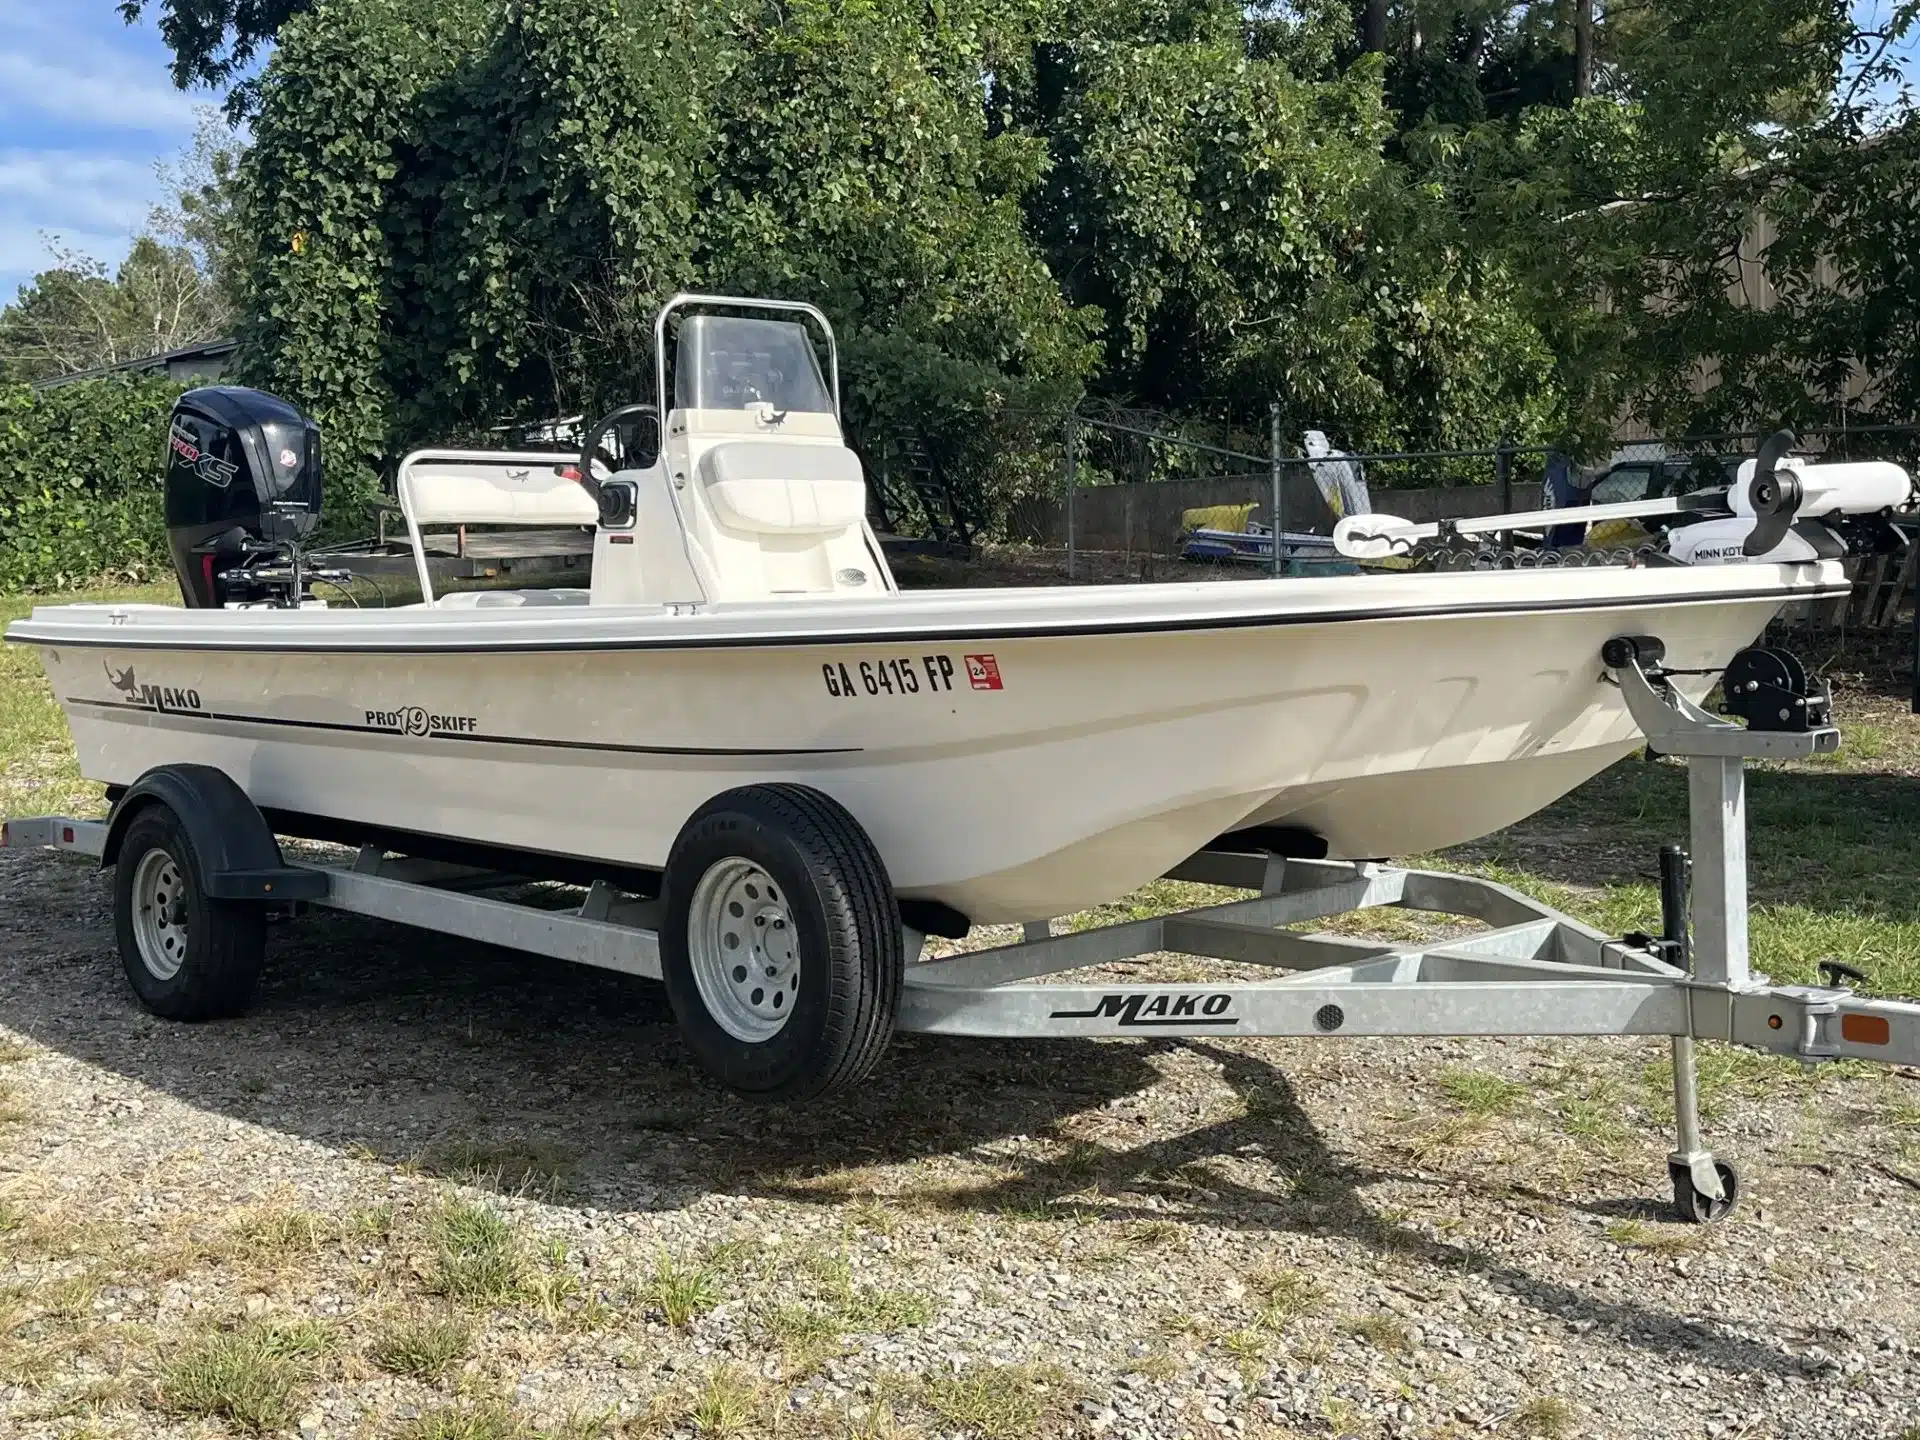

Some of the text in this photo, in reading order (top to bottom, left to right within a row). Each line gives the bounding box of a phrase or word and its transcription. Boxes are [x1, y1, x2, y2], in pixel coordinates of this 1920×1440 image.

[179, 452, 239, 488] XS
[1695, 546, 1743, 560] MINN KOT
[822, 662, 857, 697] GA
[859, 658, 919, 695] 6415
[922, 655, 954, 692] FP
[972, 667, 985, 676] 24
[139, 684, 201, 711] MAKO
[365, 706, 477, 737] PRO 19 SKIFF
[1094, 994, 1233, 1026] MAKO
